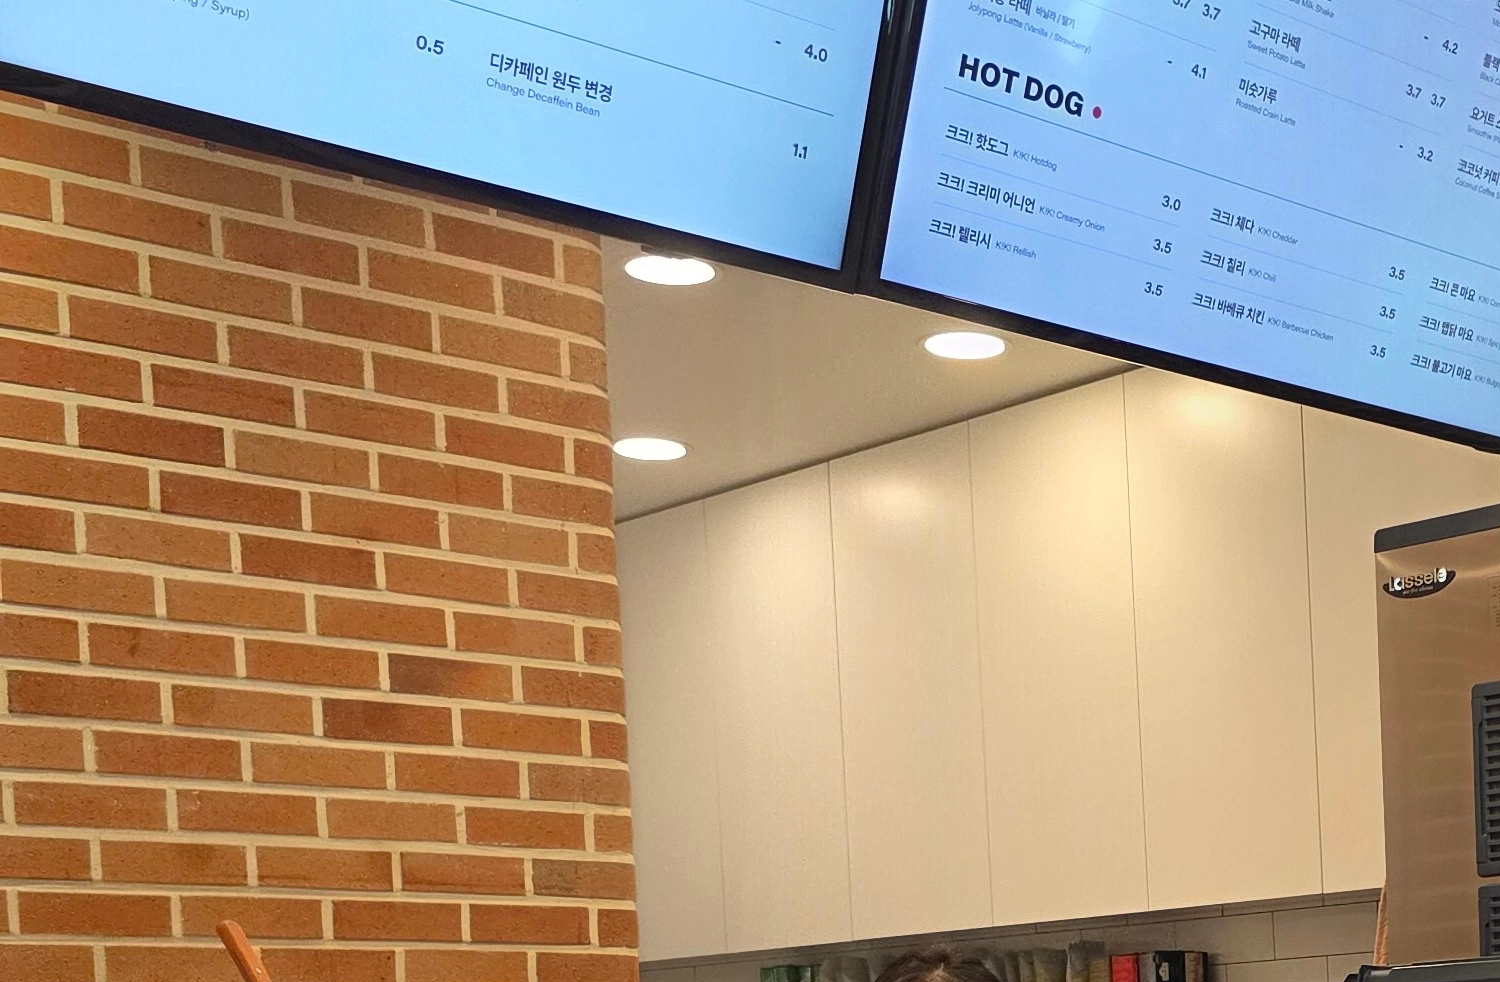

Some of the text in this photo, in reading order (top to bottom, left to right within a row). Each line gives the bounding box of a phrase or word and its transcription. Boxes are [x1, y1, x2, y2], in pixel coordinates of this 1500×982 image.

[210, 0, 249, 21] Syrup)
[1202, 3, 1221, 21] 3.7
[1249, 20, 1280, 45] 고구마
[416, 34, 445, 56] 0.5
[804, 43, 829, 62] 4.0
[1442, 40, 1459, 55] 4.2
[489, 52, 613, 104] 디카페인 원두 변경
[1191, 63, 1207, 80] 4.1
[958, 53, 1084, 117] HOT DOG
[1238, 78, 1277, 104] 미숫가루
[486, 76, 600, 118] Change Decaffein Bean
[1406, 84, 1446, 108] 3.7 3.7
[1469, 107, 1495, 126] 요거트
[792, 143, 808, 161] 1.1
[945, 124, 974, 146] 크크!
[975, 131, 1009, 156] 핫도그
[1030, 153, 1058, 172] Hotdog
[1417, 146, 1434, 162] 3.2
[1457, 158, 1484, 180] 코코넛
[1484, 168, 1500, 187] 커피
[937, 171, 964, 193] 크크!
[966, 179, 1000, 205] 크리미
[1001, 190, 1035, 215] 어니언
[1162, 194, 1182, 212] 3.0
[1210, 208, 1234, 227] 크크!
[1235, 215, 1255, 235] 체다
[928, 218, 956, 240] 크크!
[958, 226, 991, 251] 렐리시
[1152, 238, 1173, 255] 3.5
[1200, 250, 1225, 269] 크크!
[1226, 256, 1246, 277] 칠리
[1388, 266, 1405, 281] 3.5
[1143, 281, 1164, 297] 3.5
[1460, 285, 1476, 302] 마요
[1191, 292, 1216, 311] 크크!
[1217, 298, 1245, 319] 바베큐
[1246, 307, 1266, 325] 치킨
[1379, 306, 1396, 320] 3.5
[1458, 326, 1474, 342] 마요
[1369, 344, 1386, 359] 3.5
[1431, 359, 1456, 380] 불고기
[1456, 365, 1472, 381] 마요
